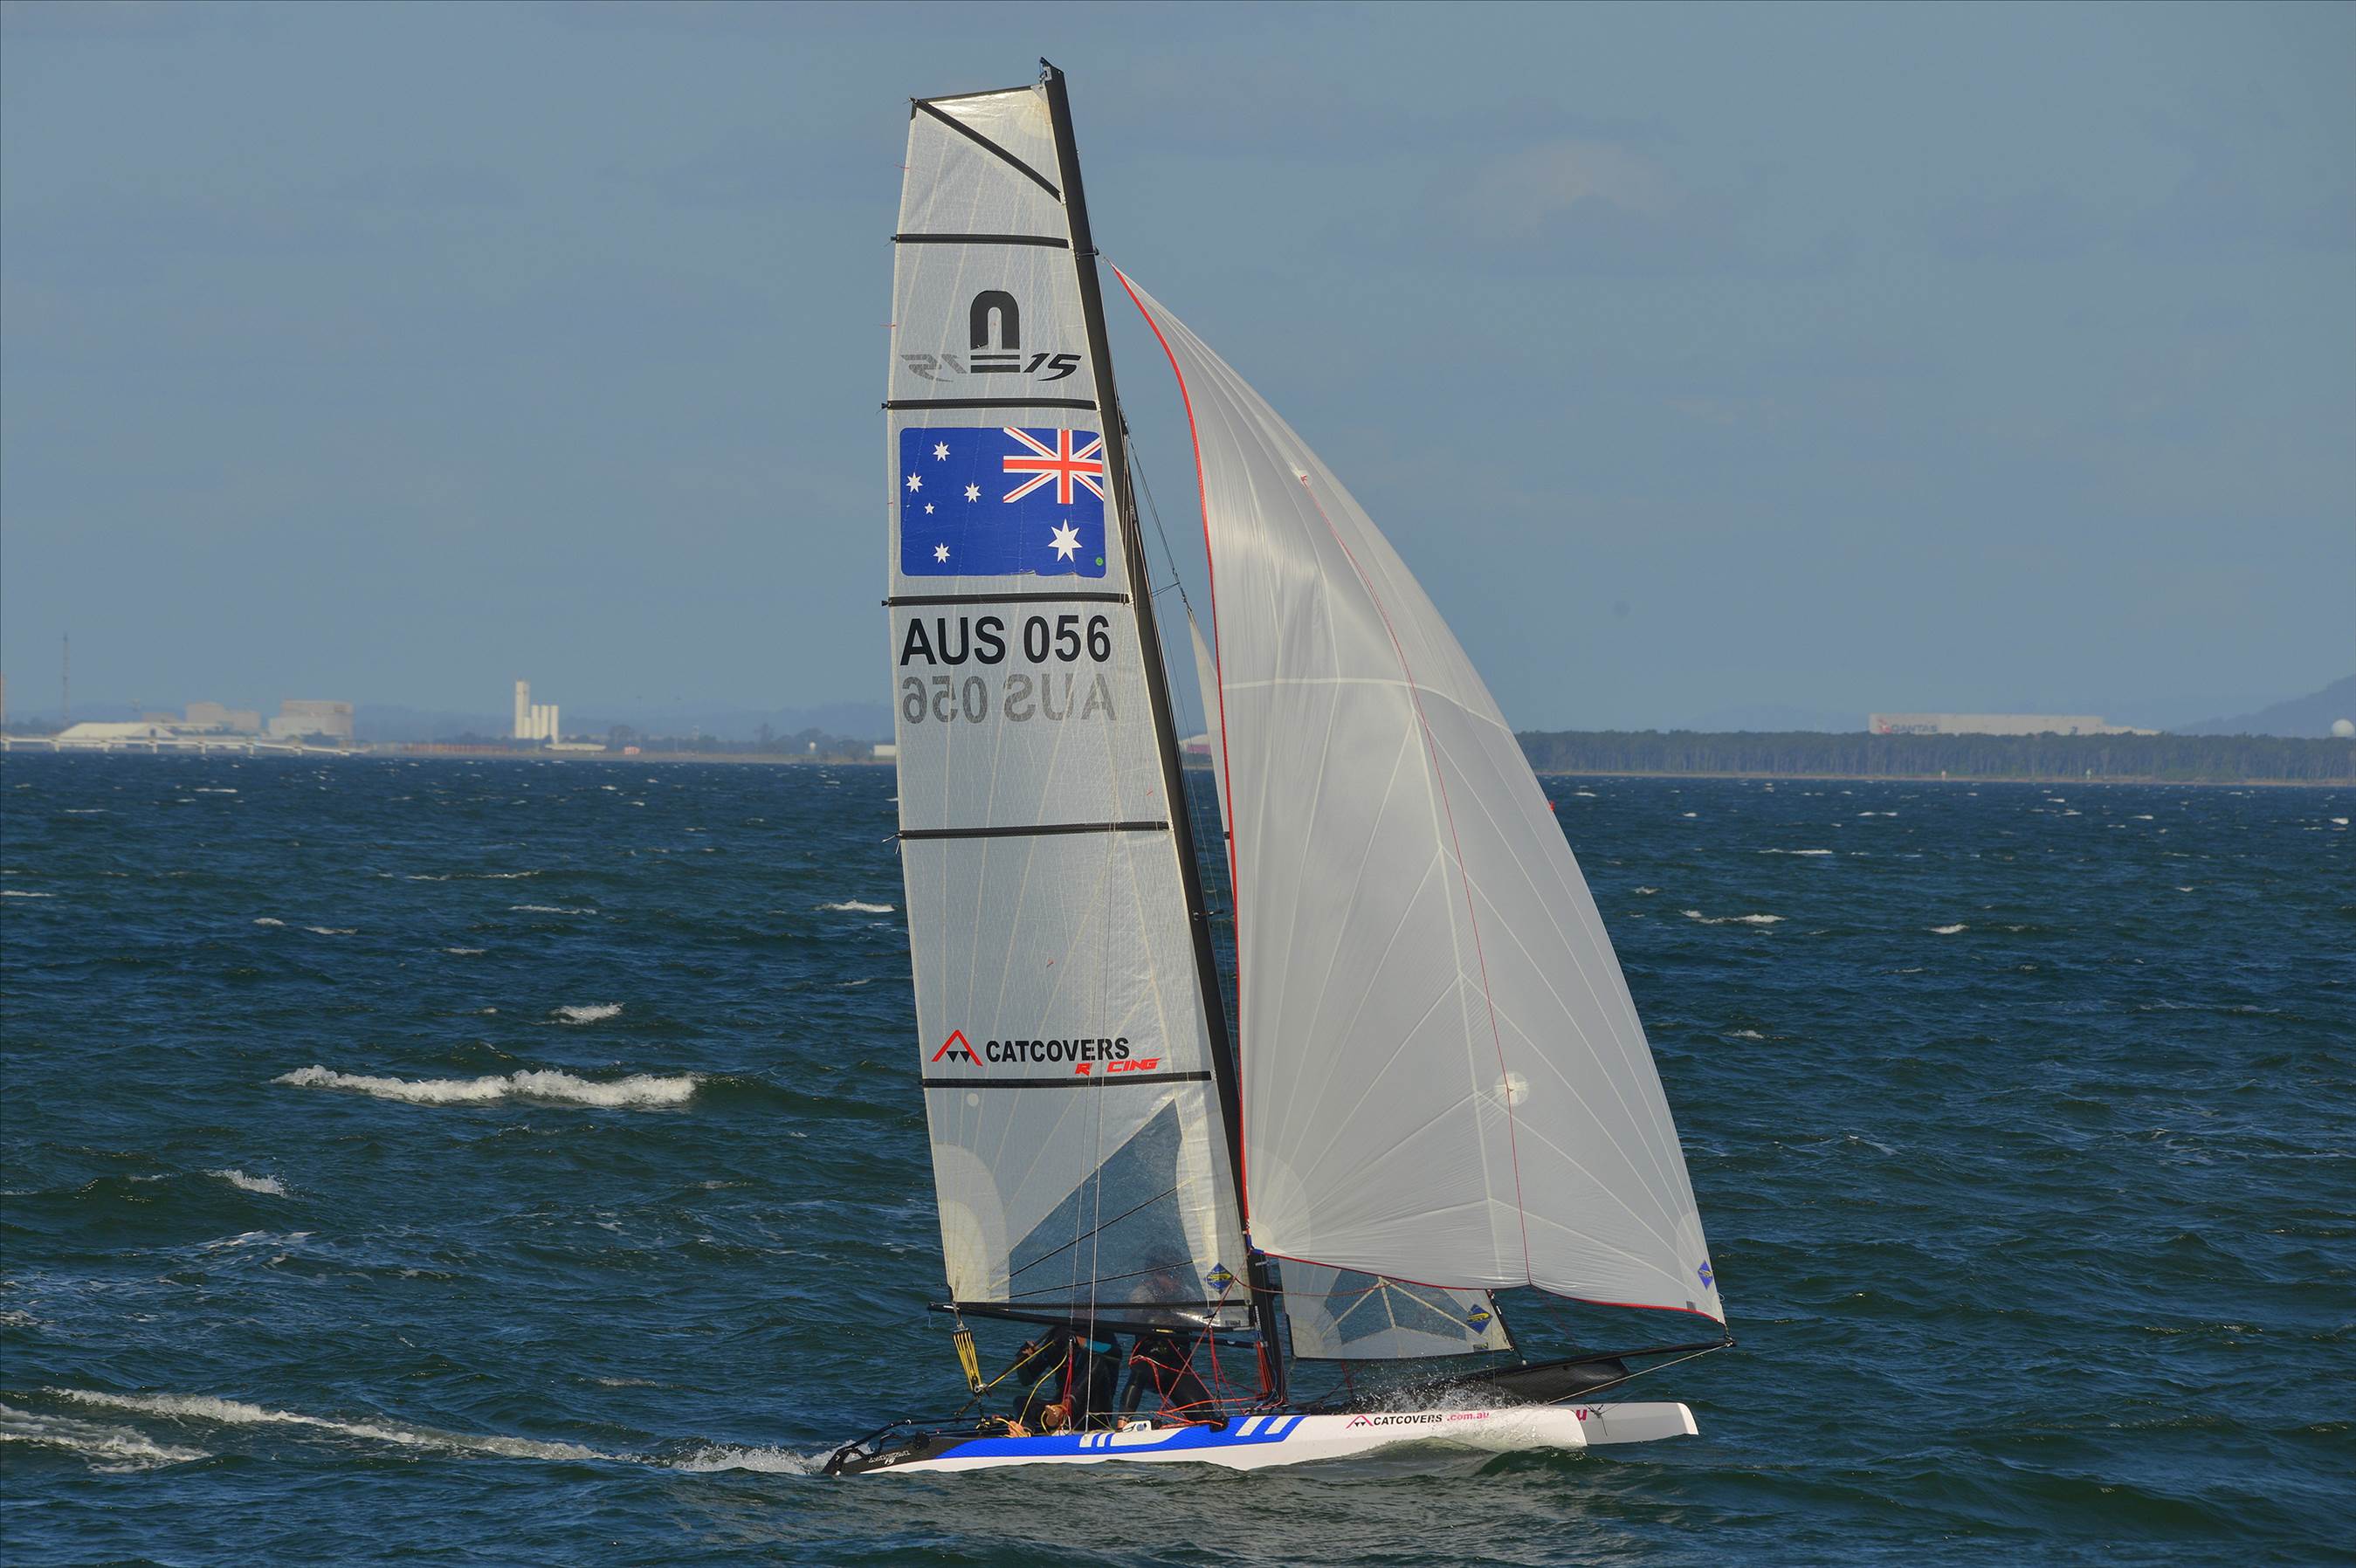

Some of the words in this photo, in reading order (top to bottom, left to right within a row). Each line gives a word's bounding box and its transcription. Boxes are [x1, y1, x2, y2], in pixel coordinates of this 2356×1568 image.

[1023, 353, 1082, 382] 15
[899, 616, 1006, 665] AUS
[1023, 615, 1111, 664] 056
[986, 1037, 1130, 1063] CATCOVERS
[1075, 1057, 1161, 1076] RCING
[1374, 1414, 1443, 1426] CATCOVERS
